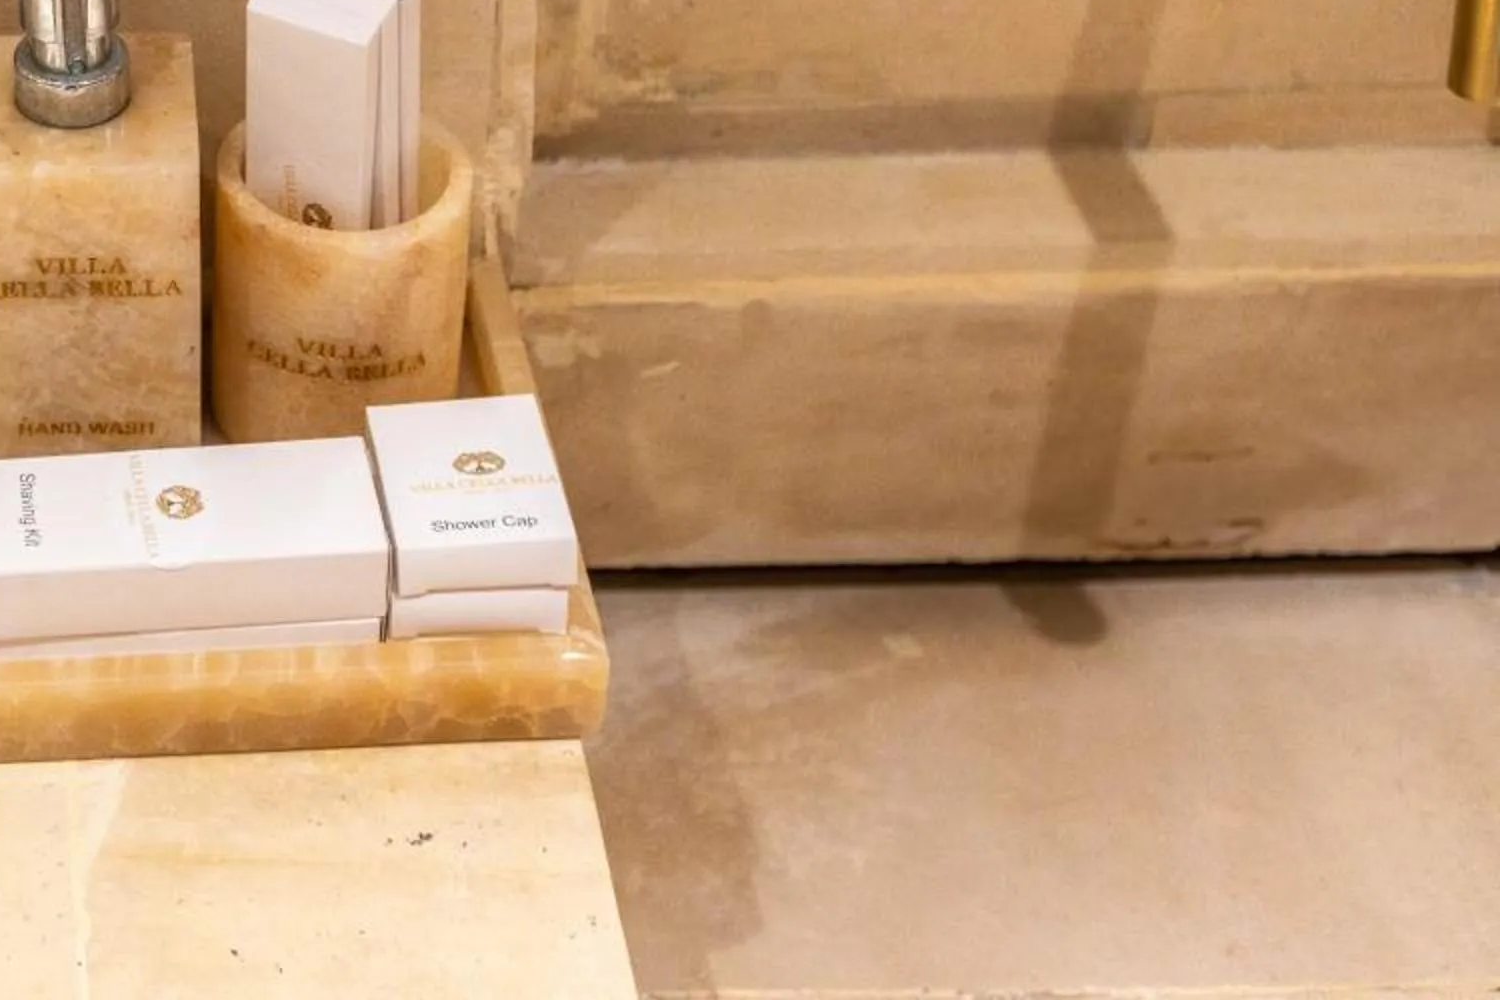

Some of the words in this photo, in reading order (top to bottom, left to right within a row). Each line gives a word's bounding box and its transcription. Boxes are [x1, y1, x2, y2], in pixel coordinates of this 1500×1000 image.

[35, 256, 128, 276] VILLA
[88, 279, 183, 298] BELLA
[296, 337, 383, 359] VILLA
[18, 420, 82, 437] HAND
[88, 420, 156, 436] WASH
[18, 472, 37, 526] Shaving
[430, 516, 497, 533] Shower
[501, 514, 539, 530] Cap
[23, 528, 43, 548] Kit
